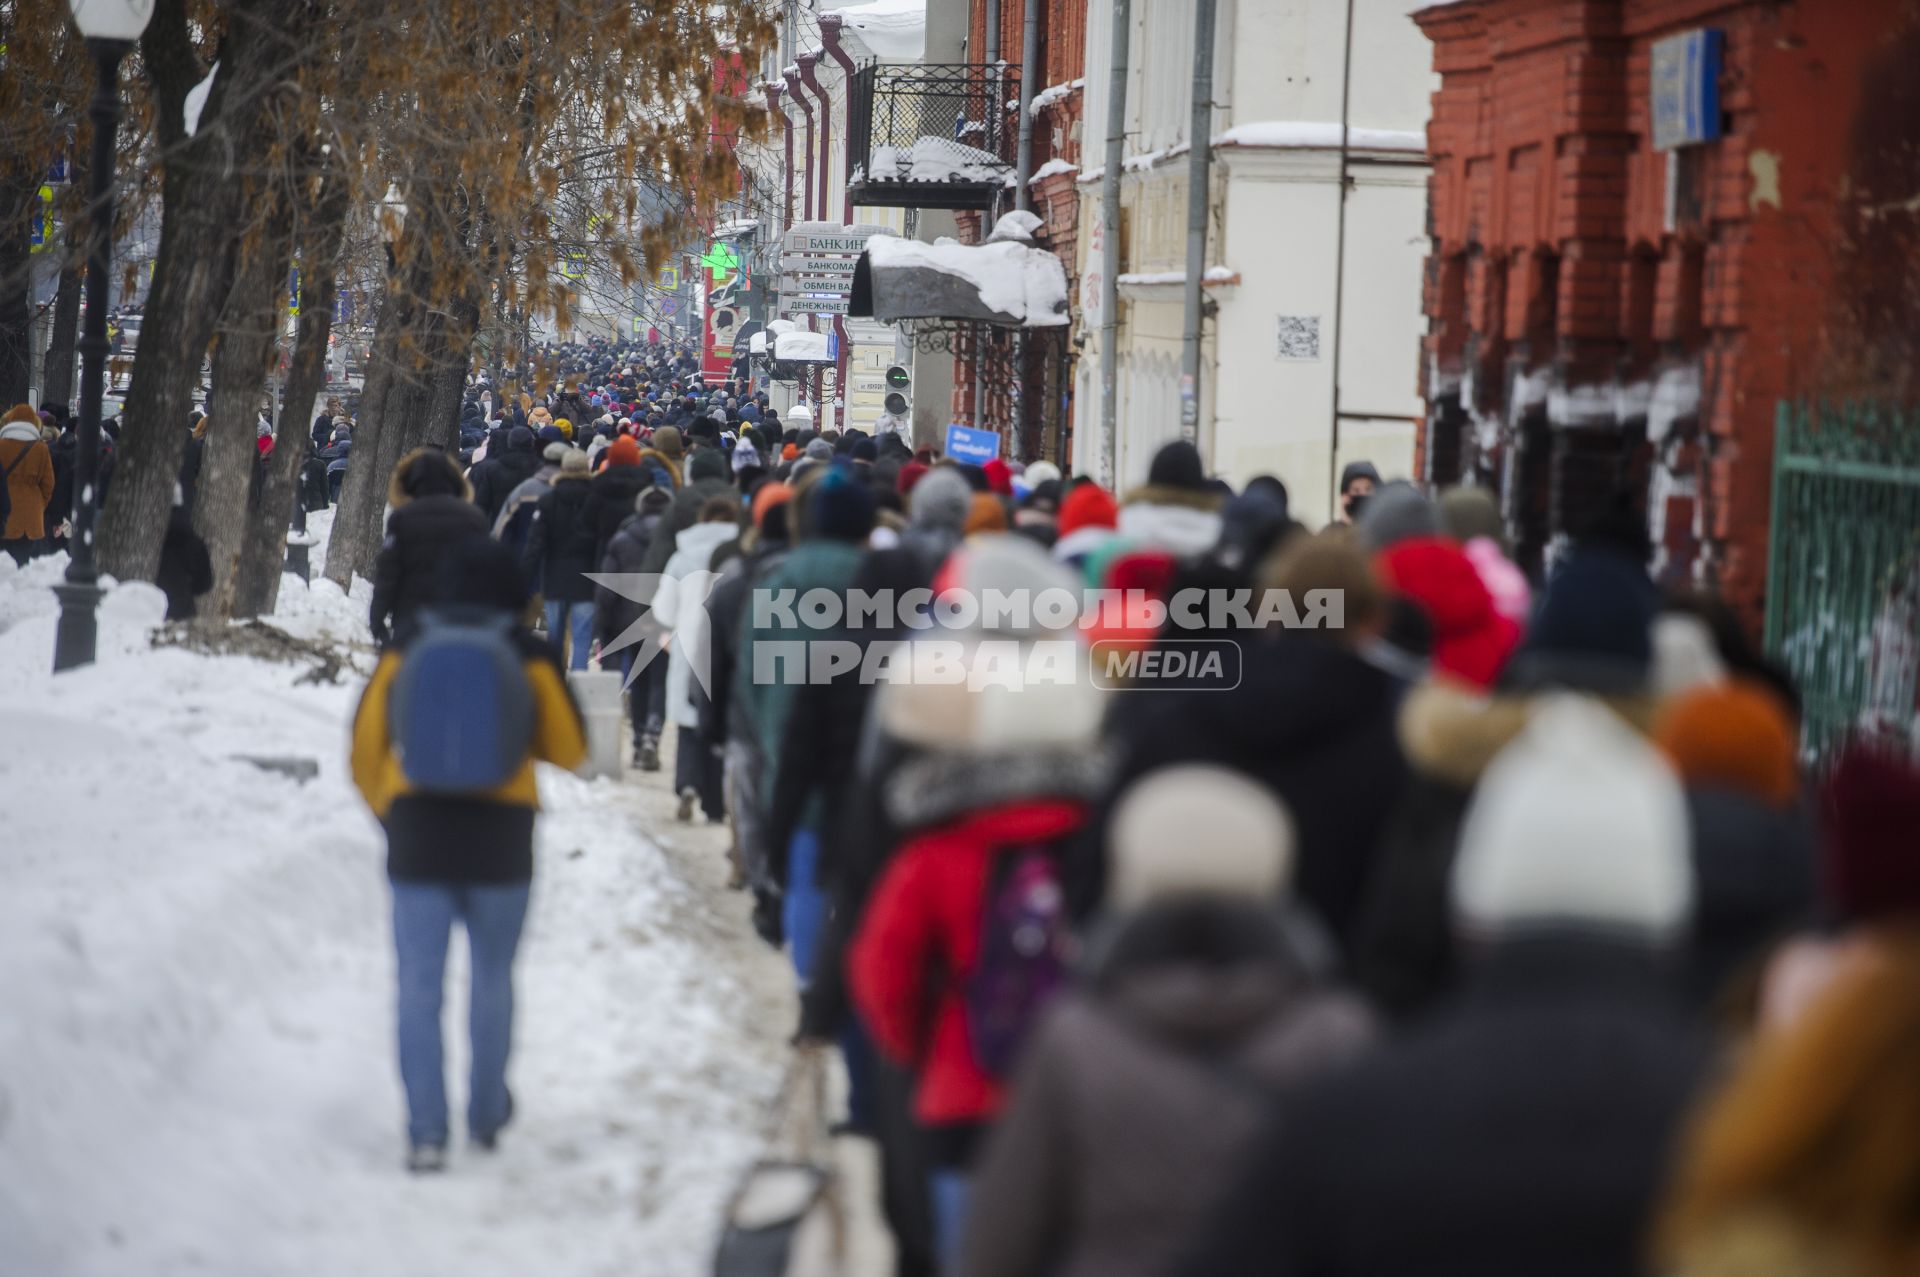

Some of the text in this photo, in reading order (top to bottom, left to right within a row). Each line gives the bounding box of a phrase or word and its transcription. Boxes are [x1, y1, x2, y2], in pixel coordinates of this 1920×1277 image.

[810, 238, 843, 250] БАНК
[807, 261, 857, 271] БАНКОМА
[803, 281, 853, 292] ОБМЕН ВА
[790, 301, 841, 311] ДЕНЕЖНЫЕ
